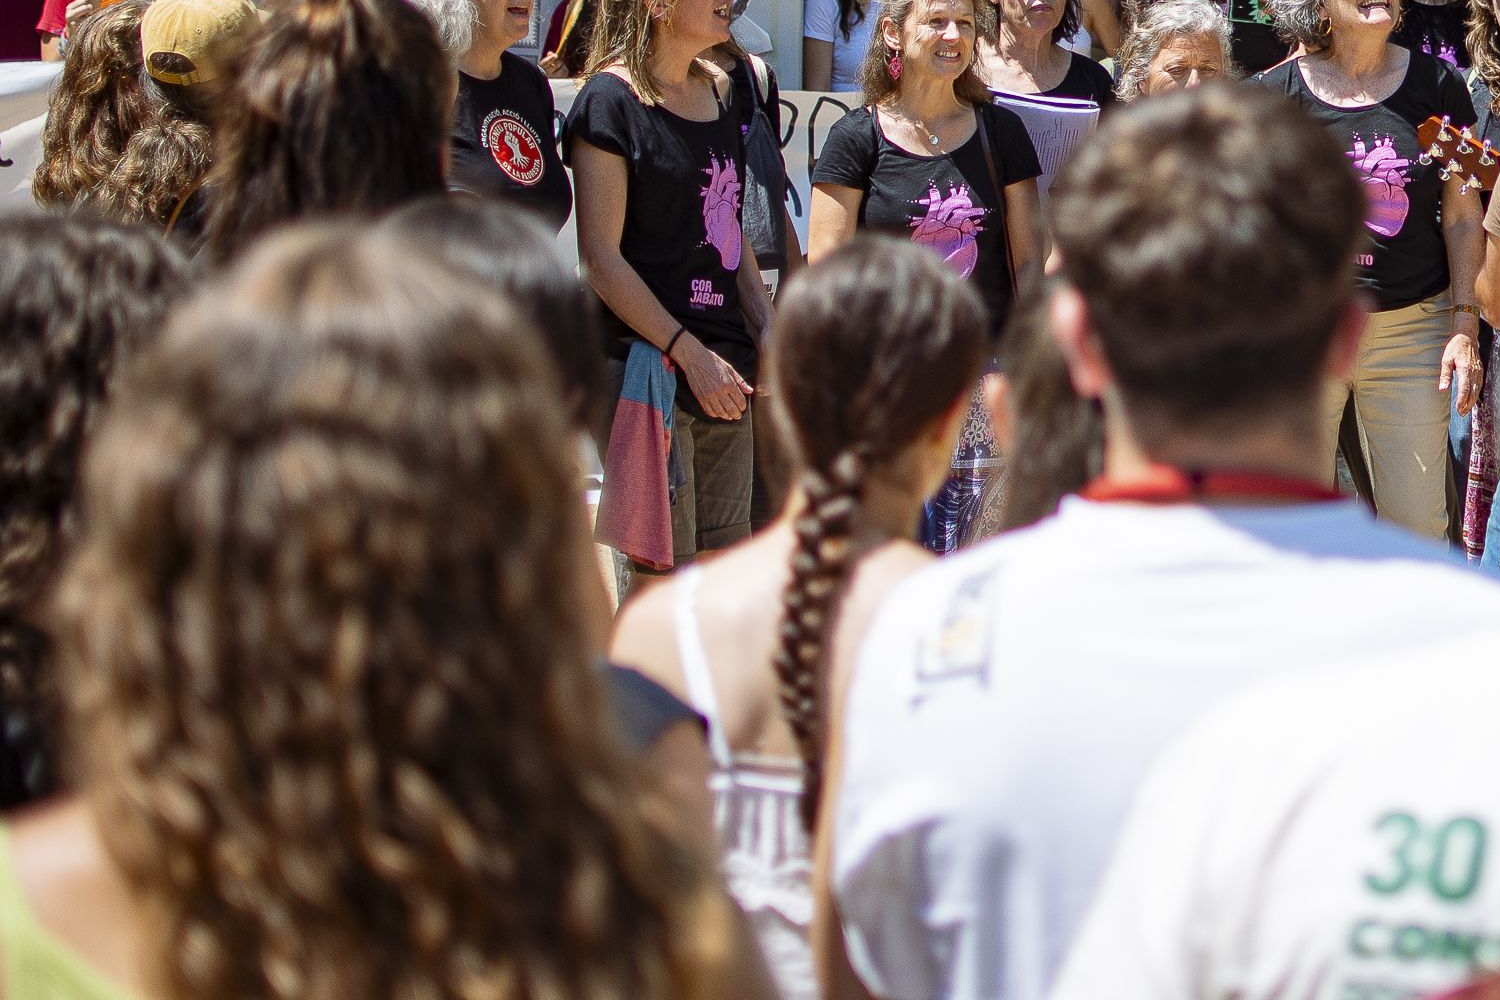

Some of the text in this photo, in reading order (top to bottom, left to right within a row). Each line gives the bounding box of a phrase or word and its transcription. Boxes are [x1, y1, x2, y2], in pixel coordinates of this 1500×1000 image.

[492, 122, 536, 152] ATENEU POPULAR
[502, 161, 512, 171] DE
[691, 279, 712, 293] COR
[690, 292, 724, 306] JABATO
[1362, 811, 1488, 901] 30
